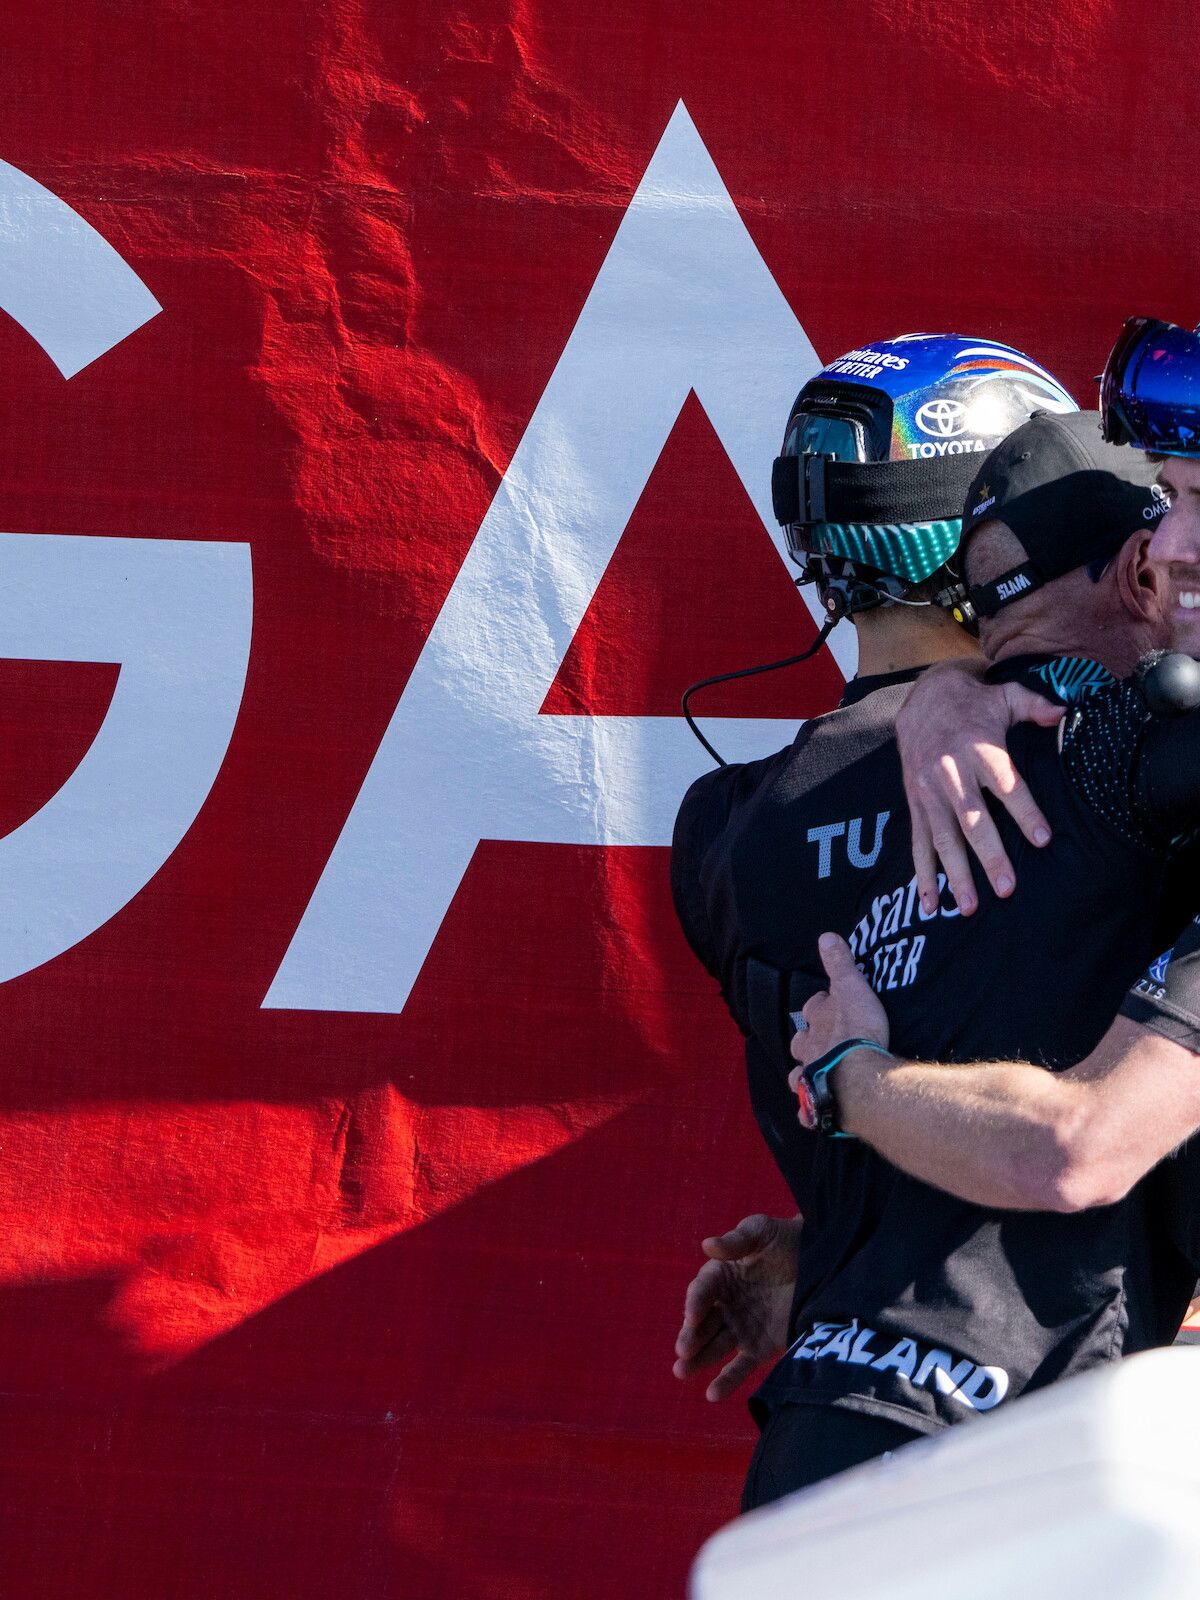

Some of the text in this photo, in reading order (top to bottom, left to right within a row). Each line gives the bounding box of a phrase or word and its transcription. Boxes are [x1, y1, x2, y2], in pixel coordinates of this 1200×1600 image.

[907, 439, 986, 460] TOYOTA
[996, 573, 1032, 601] SLAM
[788, 1318, 1009, 1410] EALAND
